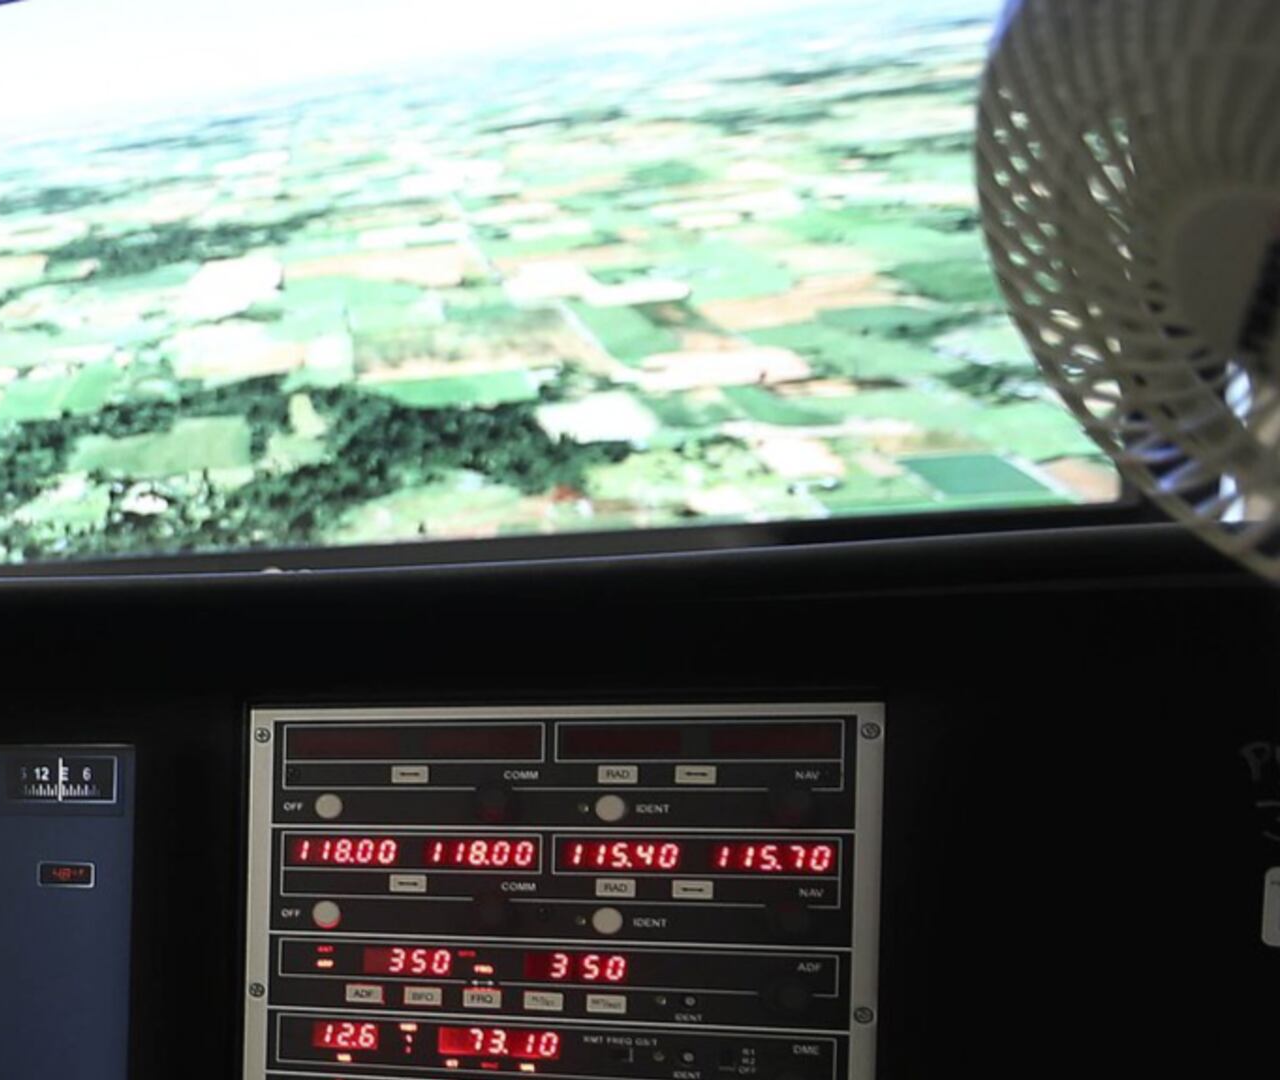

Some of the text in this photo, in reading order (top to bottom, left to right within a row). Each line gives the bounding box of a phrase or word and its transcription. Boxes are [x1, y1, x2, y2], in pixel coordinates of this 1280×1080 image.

[33, 767, 92, 782] 12 6
[503, 770, 539, 781] COMM
[605, 768, 629, 779] RAD
[794, 769, 820, 781] NAV
[283, 802, 304, 812] OFF
[635, 803, 670, 815] IDENT
[298, 839, 397, 864] 118.00
[431, 841, 535, 866] 118.00
[570, 843, 680, 871] 115.40
[716, 845, 832, 872] 115.70
[500, 881, 537, 893] COMM
[603, 883, 628, 894] RAD
[799, 887, 824, 899] NAV
[281, 908, 301, 919] OFF
[633, 917, 668, 930] IDENT
[388, 948, 452, 975] 350
[797, 961, 823, 974] ADF
[353, 990, 374, 999] ADF
[674, 1012, 703, 1022] IDENT
[324, 1022, 377, 1049] 12.6
[793, 1044, 821, 1057] DME
[673, 1070, 701, 1080] IDENT
